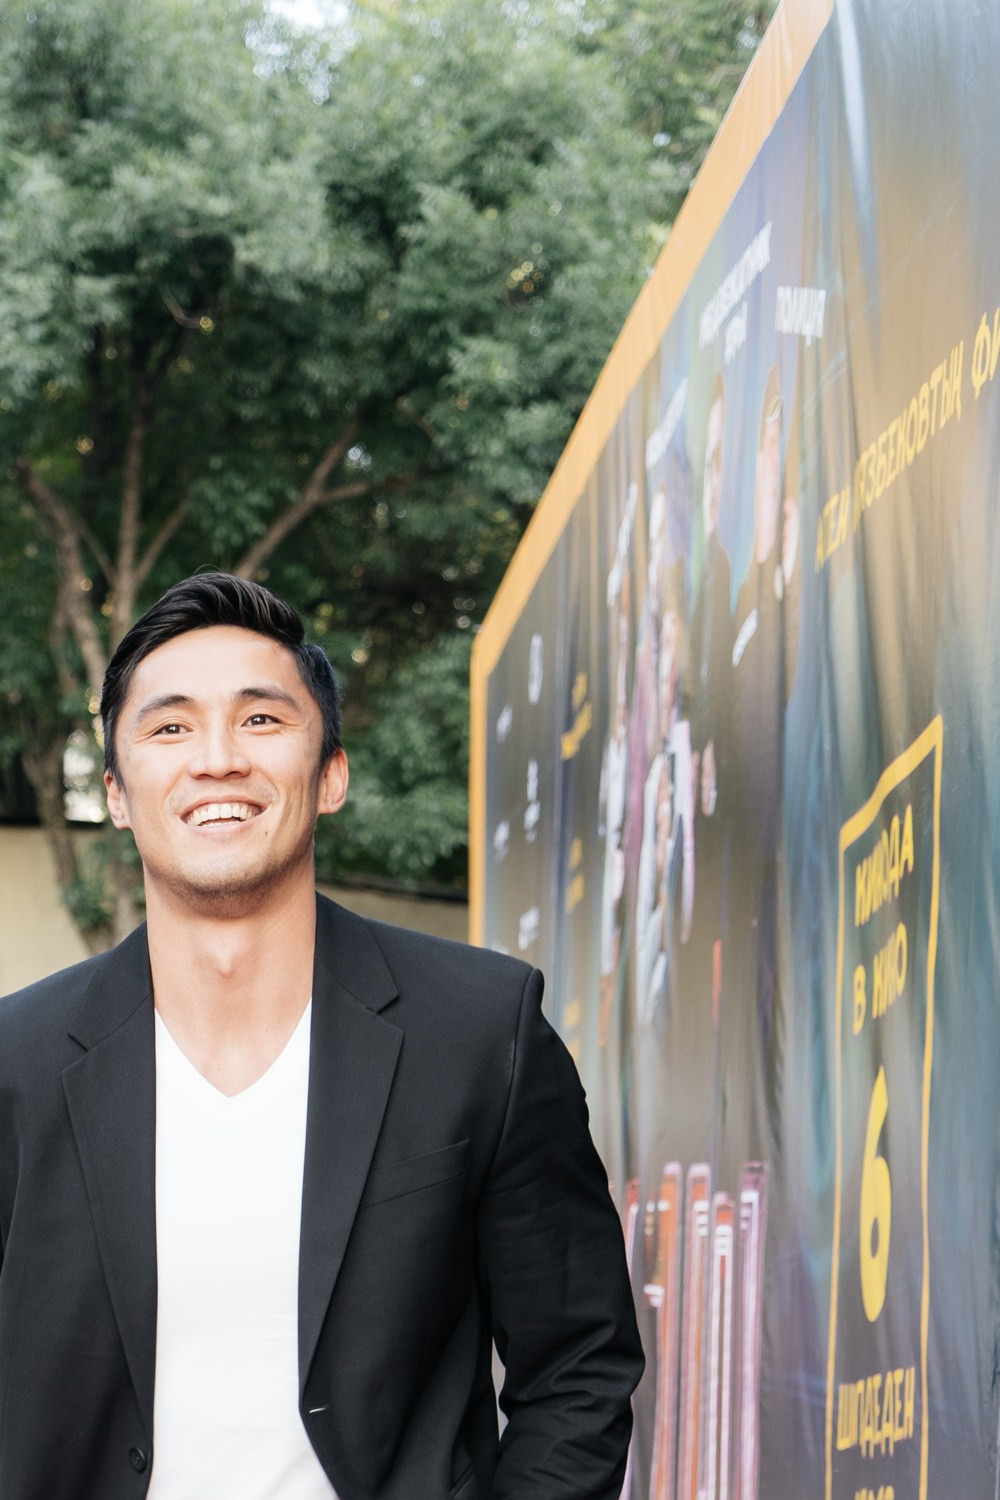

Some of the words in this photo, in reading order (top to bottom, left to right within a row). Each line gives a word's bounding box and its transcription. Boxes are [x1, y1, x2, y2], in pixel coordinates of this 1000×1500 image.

[853, 965, 866, 1036] В
[872, 922, 907, 1019] КИНО
[860, 1065, 891, 1322] 6
